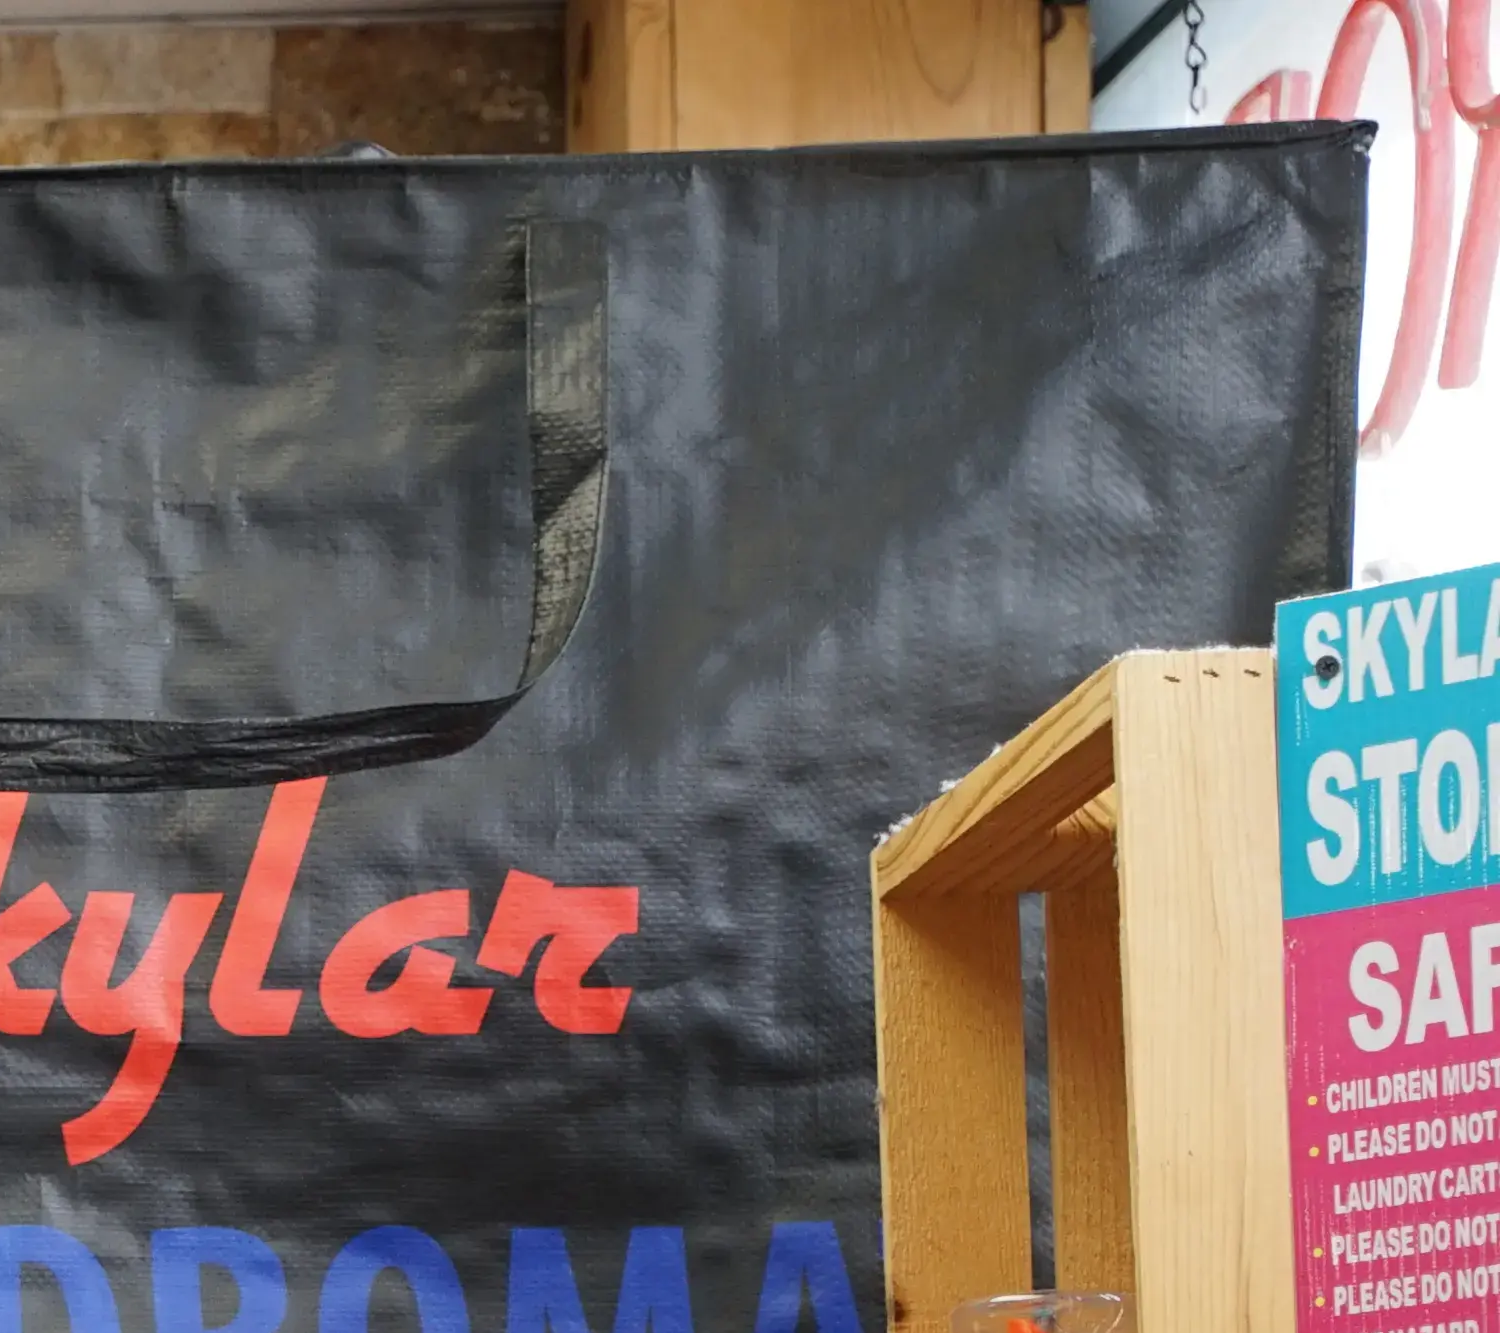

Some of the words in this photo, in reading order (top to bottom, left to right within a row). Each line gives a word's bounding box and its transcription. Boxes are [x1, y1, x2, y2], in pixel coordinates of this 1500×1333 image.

[1326, 1068, 1437, 1113] CHILDREN
[1328, 1122, 1411, 1164] PLEASE
[1416, 1118, 1447, 1152] DO
[1451, 1110, 1497, 1145] NOT
[1334, 1170, 1437, 1214] LAUNDRY
